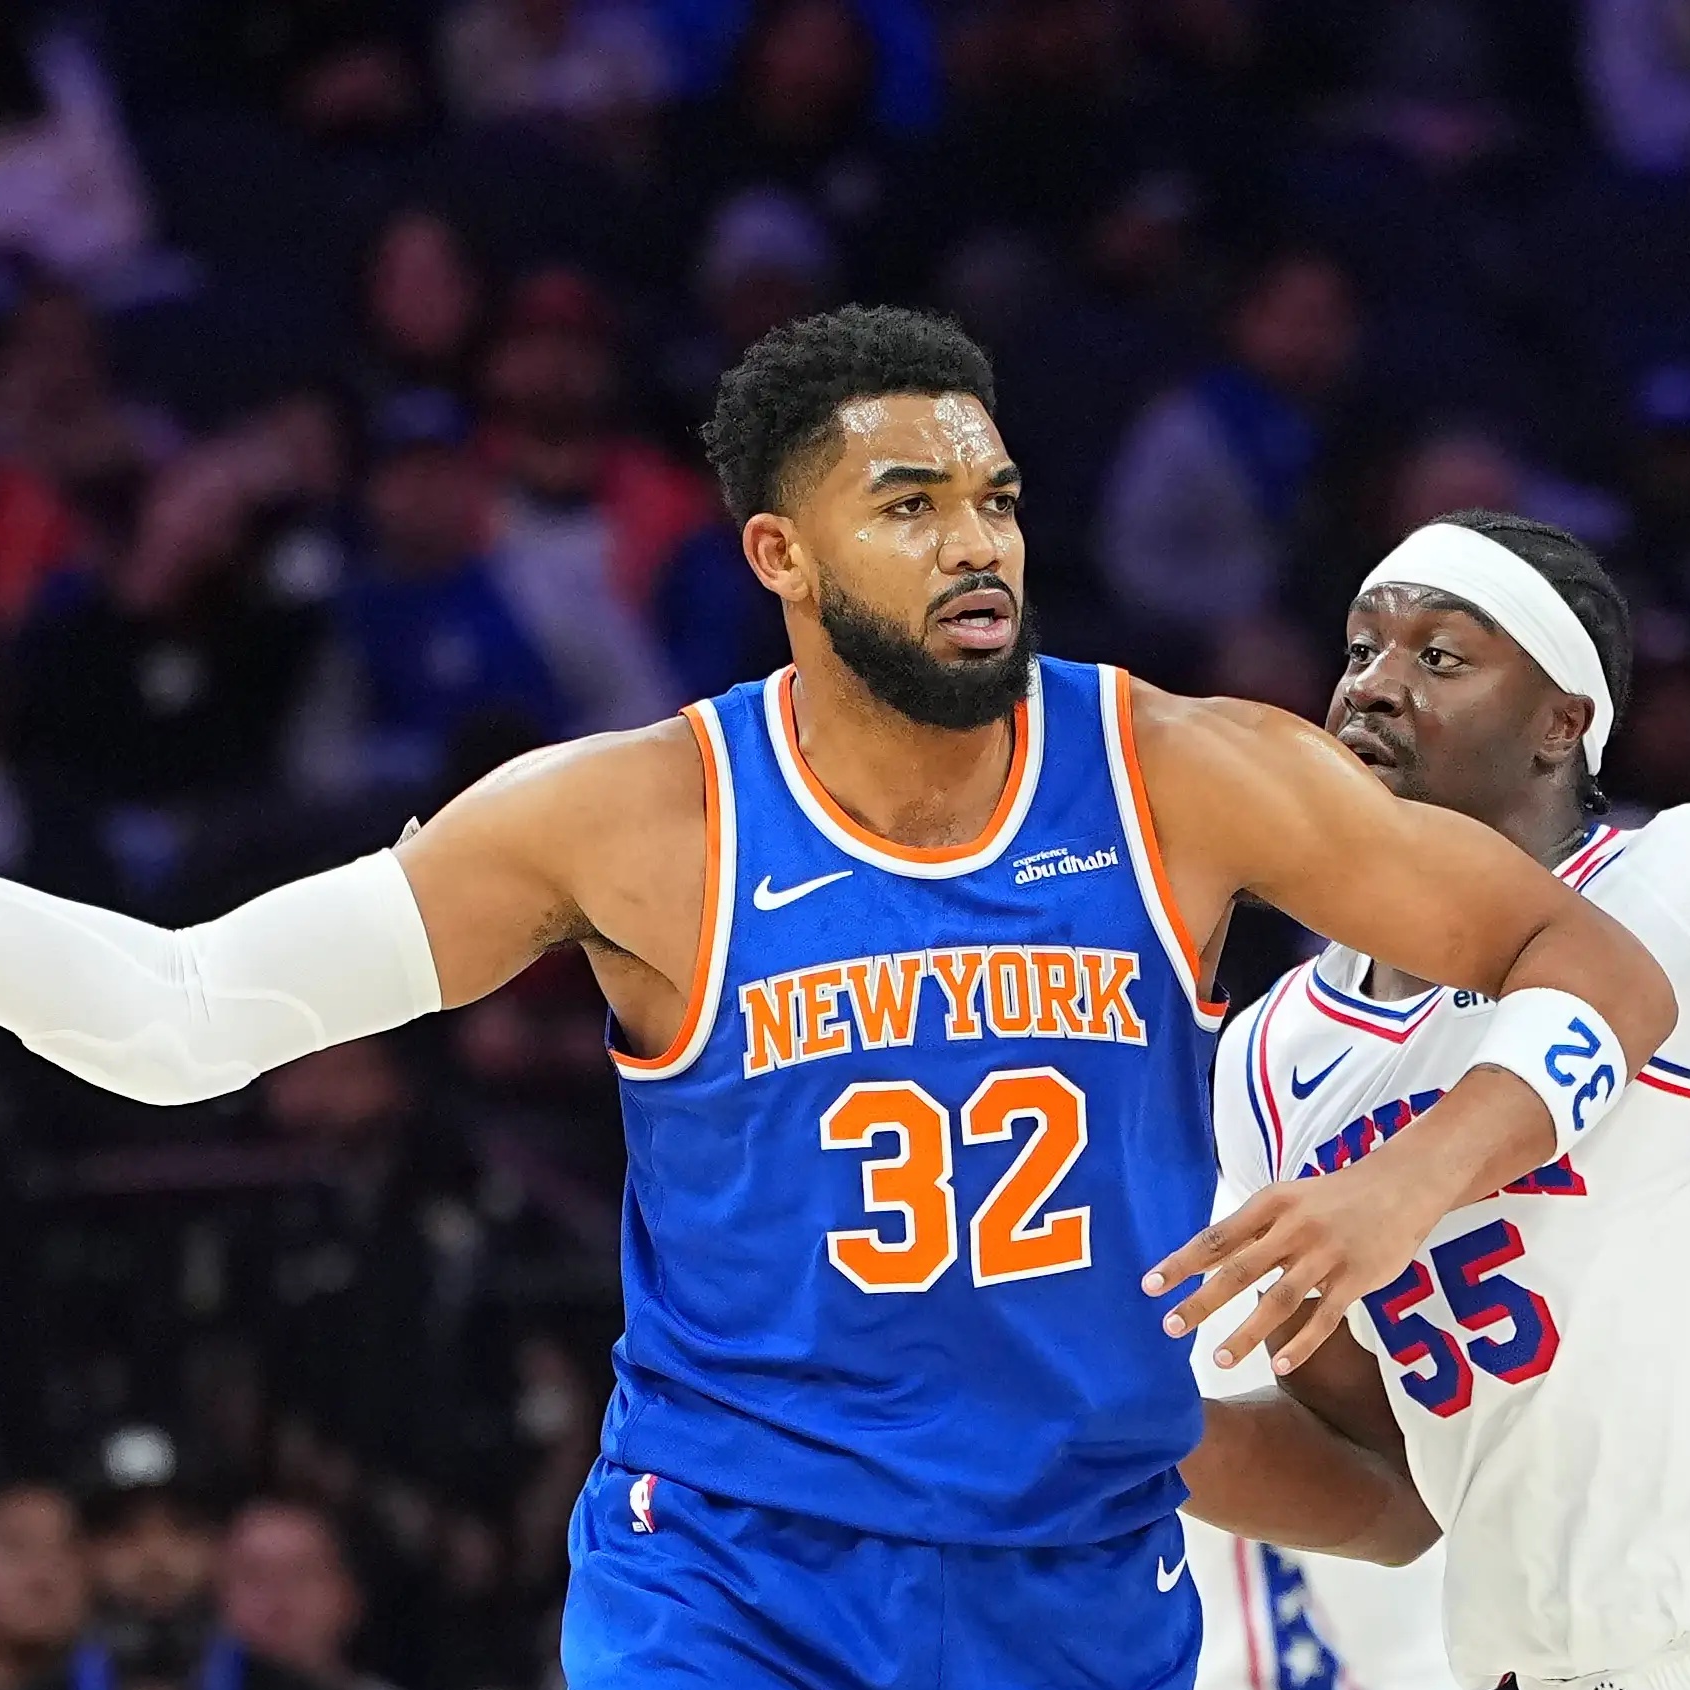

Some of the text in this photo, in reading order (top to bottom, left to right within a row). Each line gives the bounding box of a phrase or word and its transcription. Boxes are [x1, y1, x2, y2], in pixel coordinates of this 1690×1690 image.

[1012, 847, 1069, 868] experience
[1014, 863, 1057, 885] abu
[738, 945, 1149, 1080] NEW YORK
[1544, 1016, 1616, 1131] 32
[819, 1065, 1092, 1294] 32
[1361, 1218, 1561, 1419] 55
